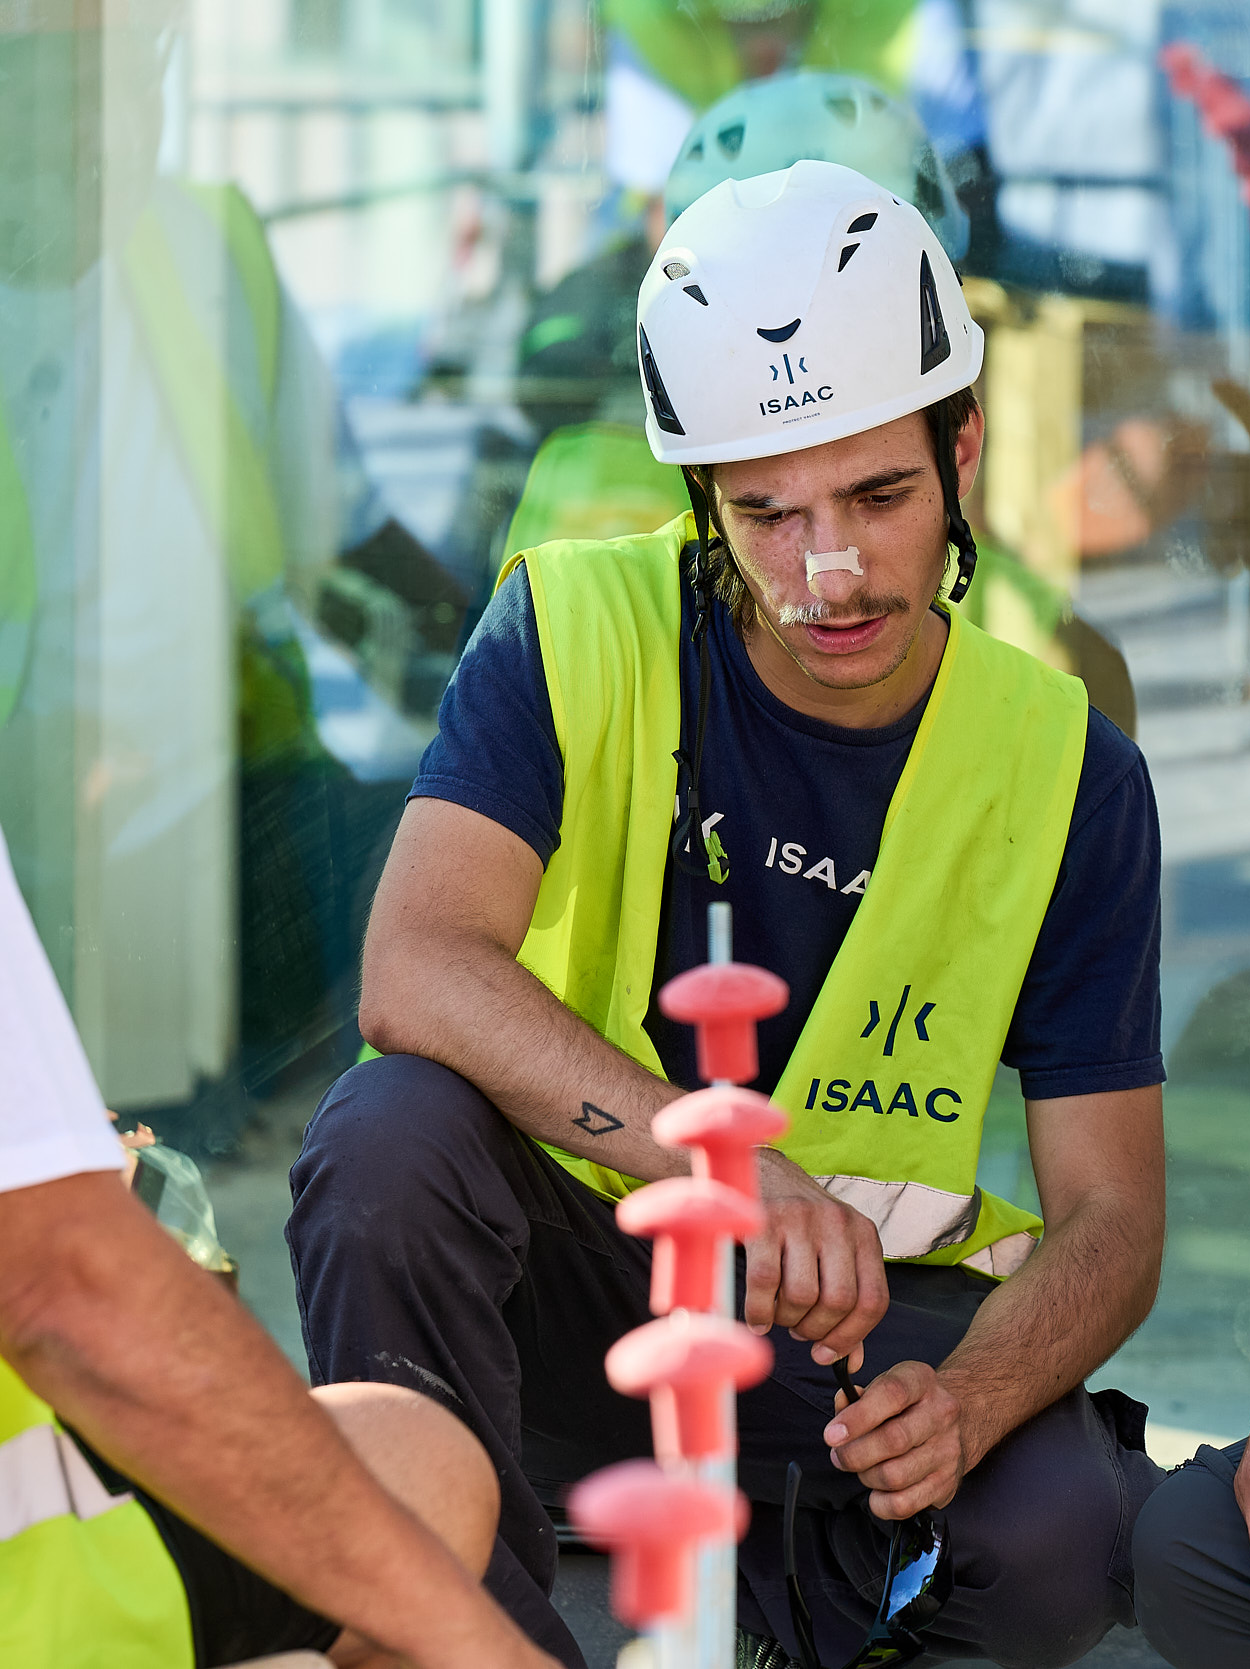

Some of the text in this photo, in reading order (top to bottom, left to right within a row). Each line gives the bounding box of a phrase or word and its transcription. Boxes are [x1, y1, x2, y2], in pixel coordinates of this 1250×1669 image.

[759, 385, 834, 416] ISAAC
[764, 836, 872, 895] ISAA
[804, 1078, 963, 1123] ISAAC
